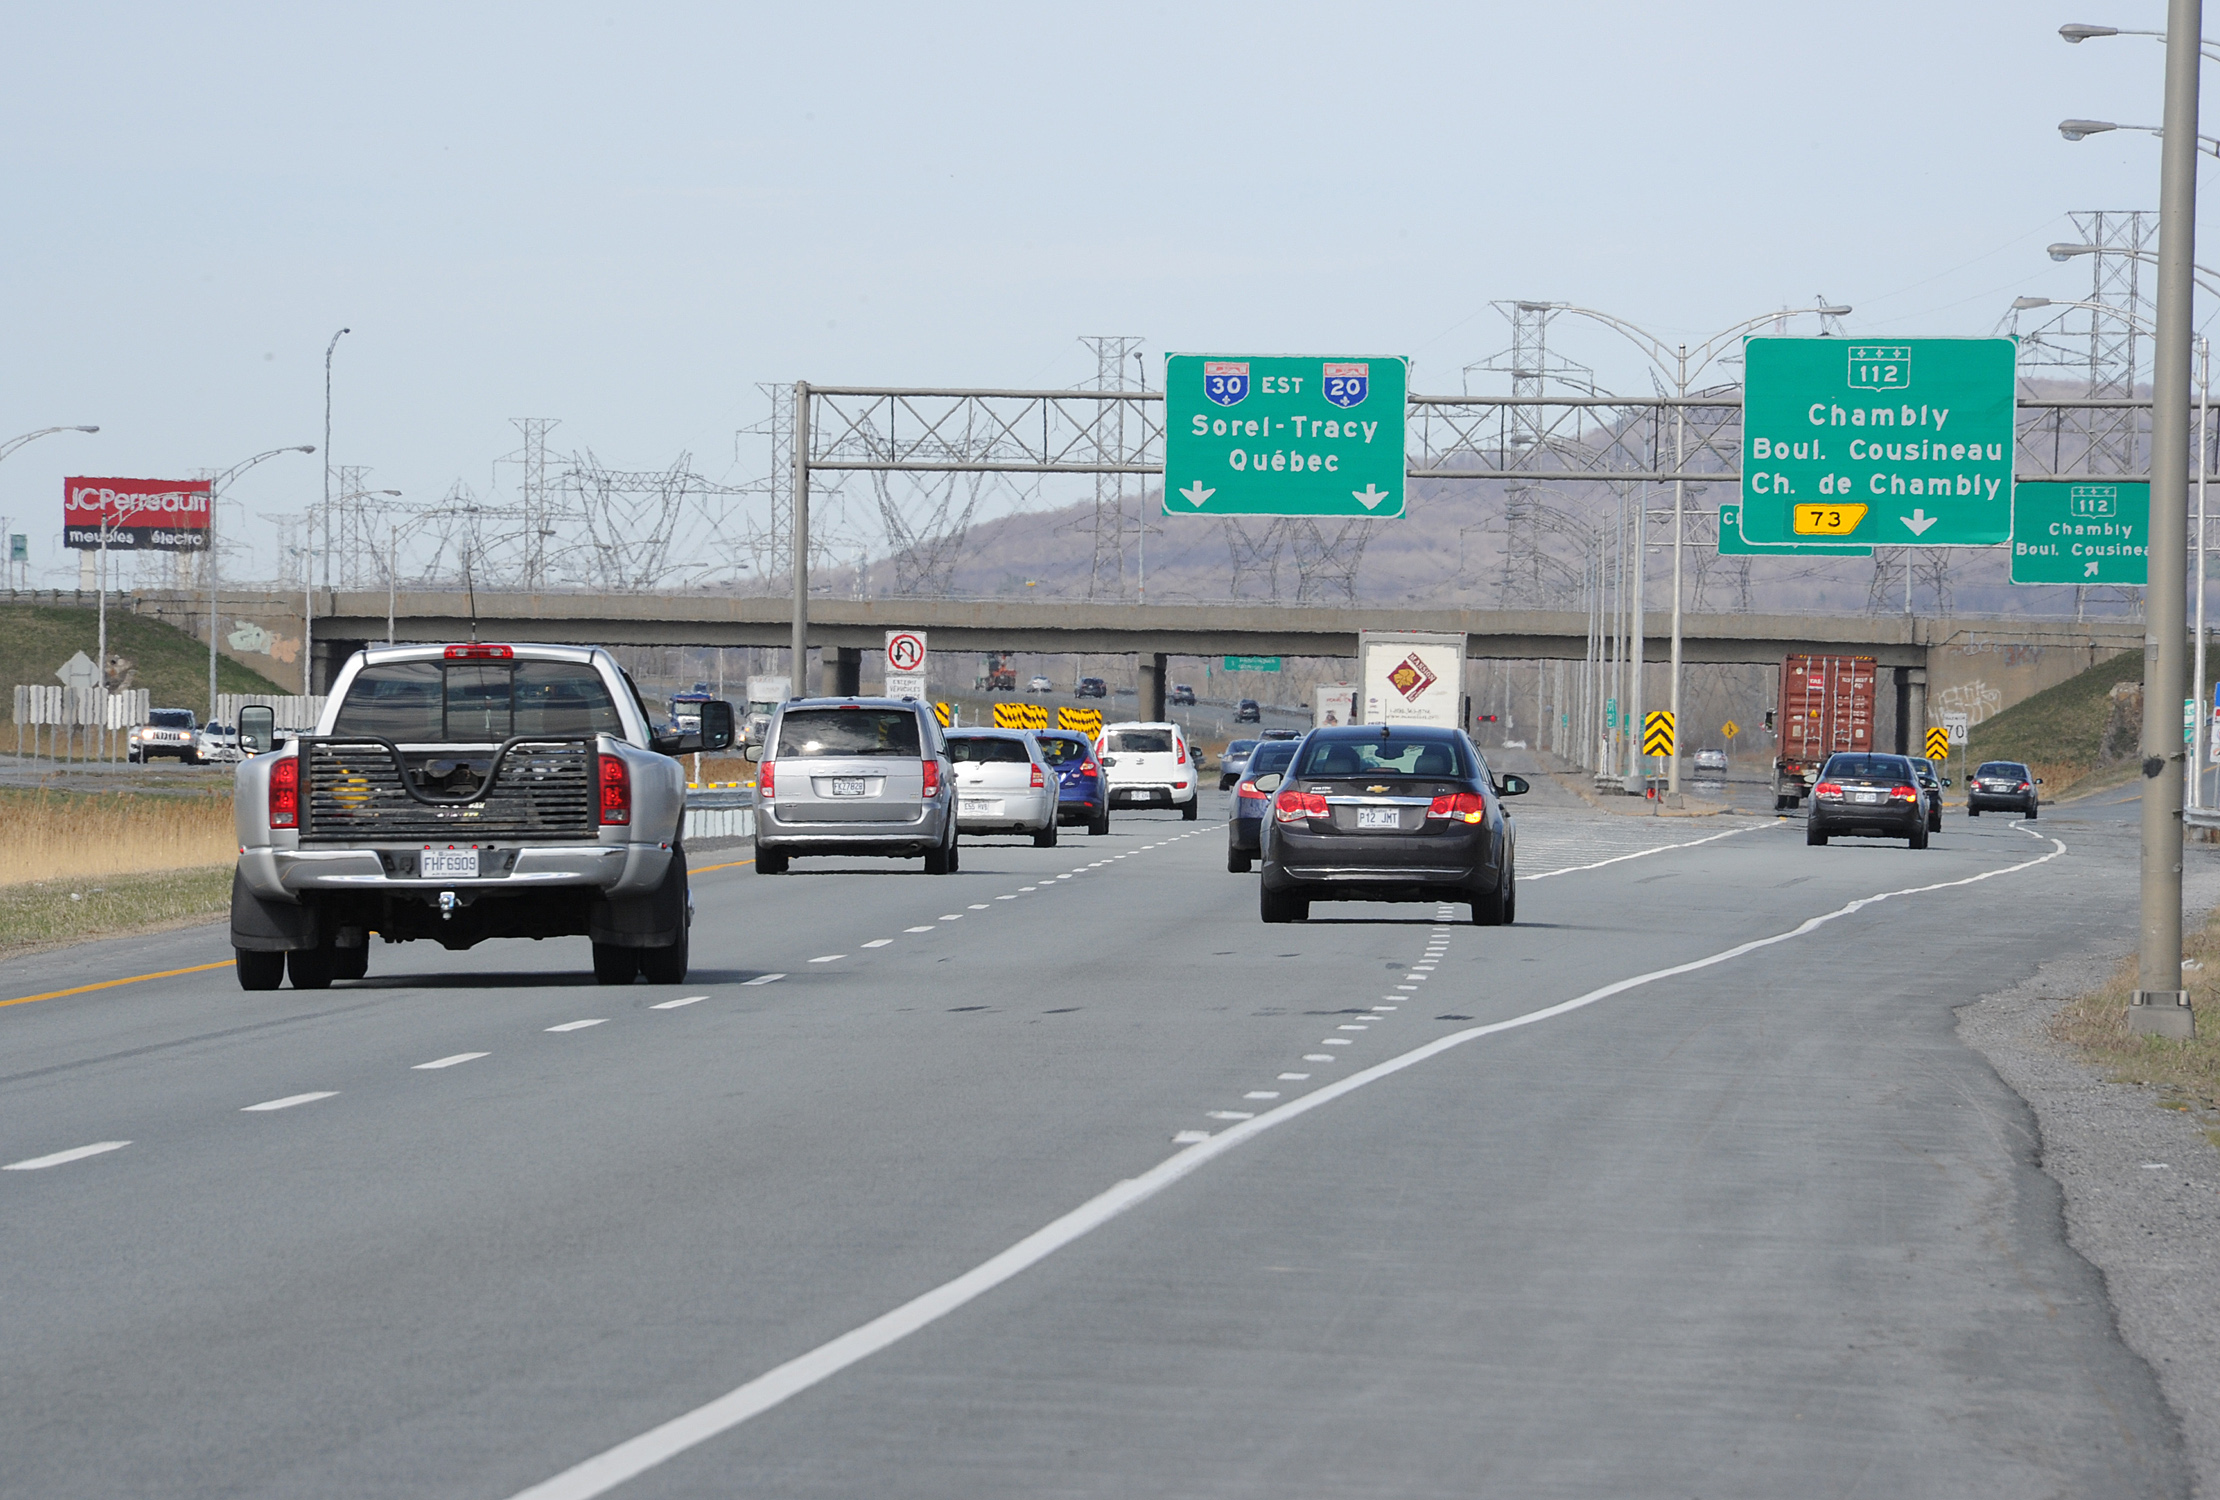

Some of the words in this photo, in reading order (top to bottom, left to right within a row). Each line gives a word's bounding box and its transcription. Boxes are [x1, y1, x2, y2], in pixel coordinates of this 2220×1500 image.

[1859, 365, 1898, 383] 112
[1211, 377, 1241, 394] 30
[1262, 376, 1304, 394] EST
[1330, 378, 1361, 396] 20
[1808, 403, 1950, 431] Chambly
[1191, 414, 1378, 444] Sorel-Tracy
[1753, 437, 1826, 460] Boul.
[1849, 438, 2002, 461] Cousineau
[1229, 448, 1339, 472] Québec
[1751, 471, 1796, 495] Ch.
[1818, 473, 1852, 495] de
[1869, 473, 2001, 500] Chambly
[2079, 499, 2108, 513] 112
[1810, 511, 1841, 527] 73
[2049, 522, 2133, 539] Chambly
[2016, 542, 2059, 556] Boul.
[1945, 724, 1965, 739] 70
[1360, 812, 1376, 823] P12
[424, 857, 476, 871] FHF6909
